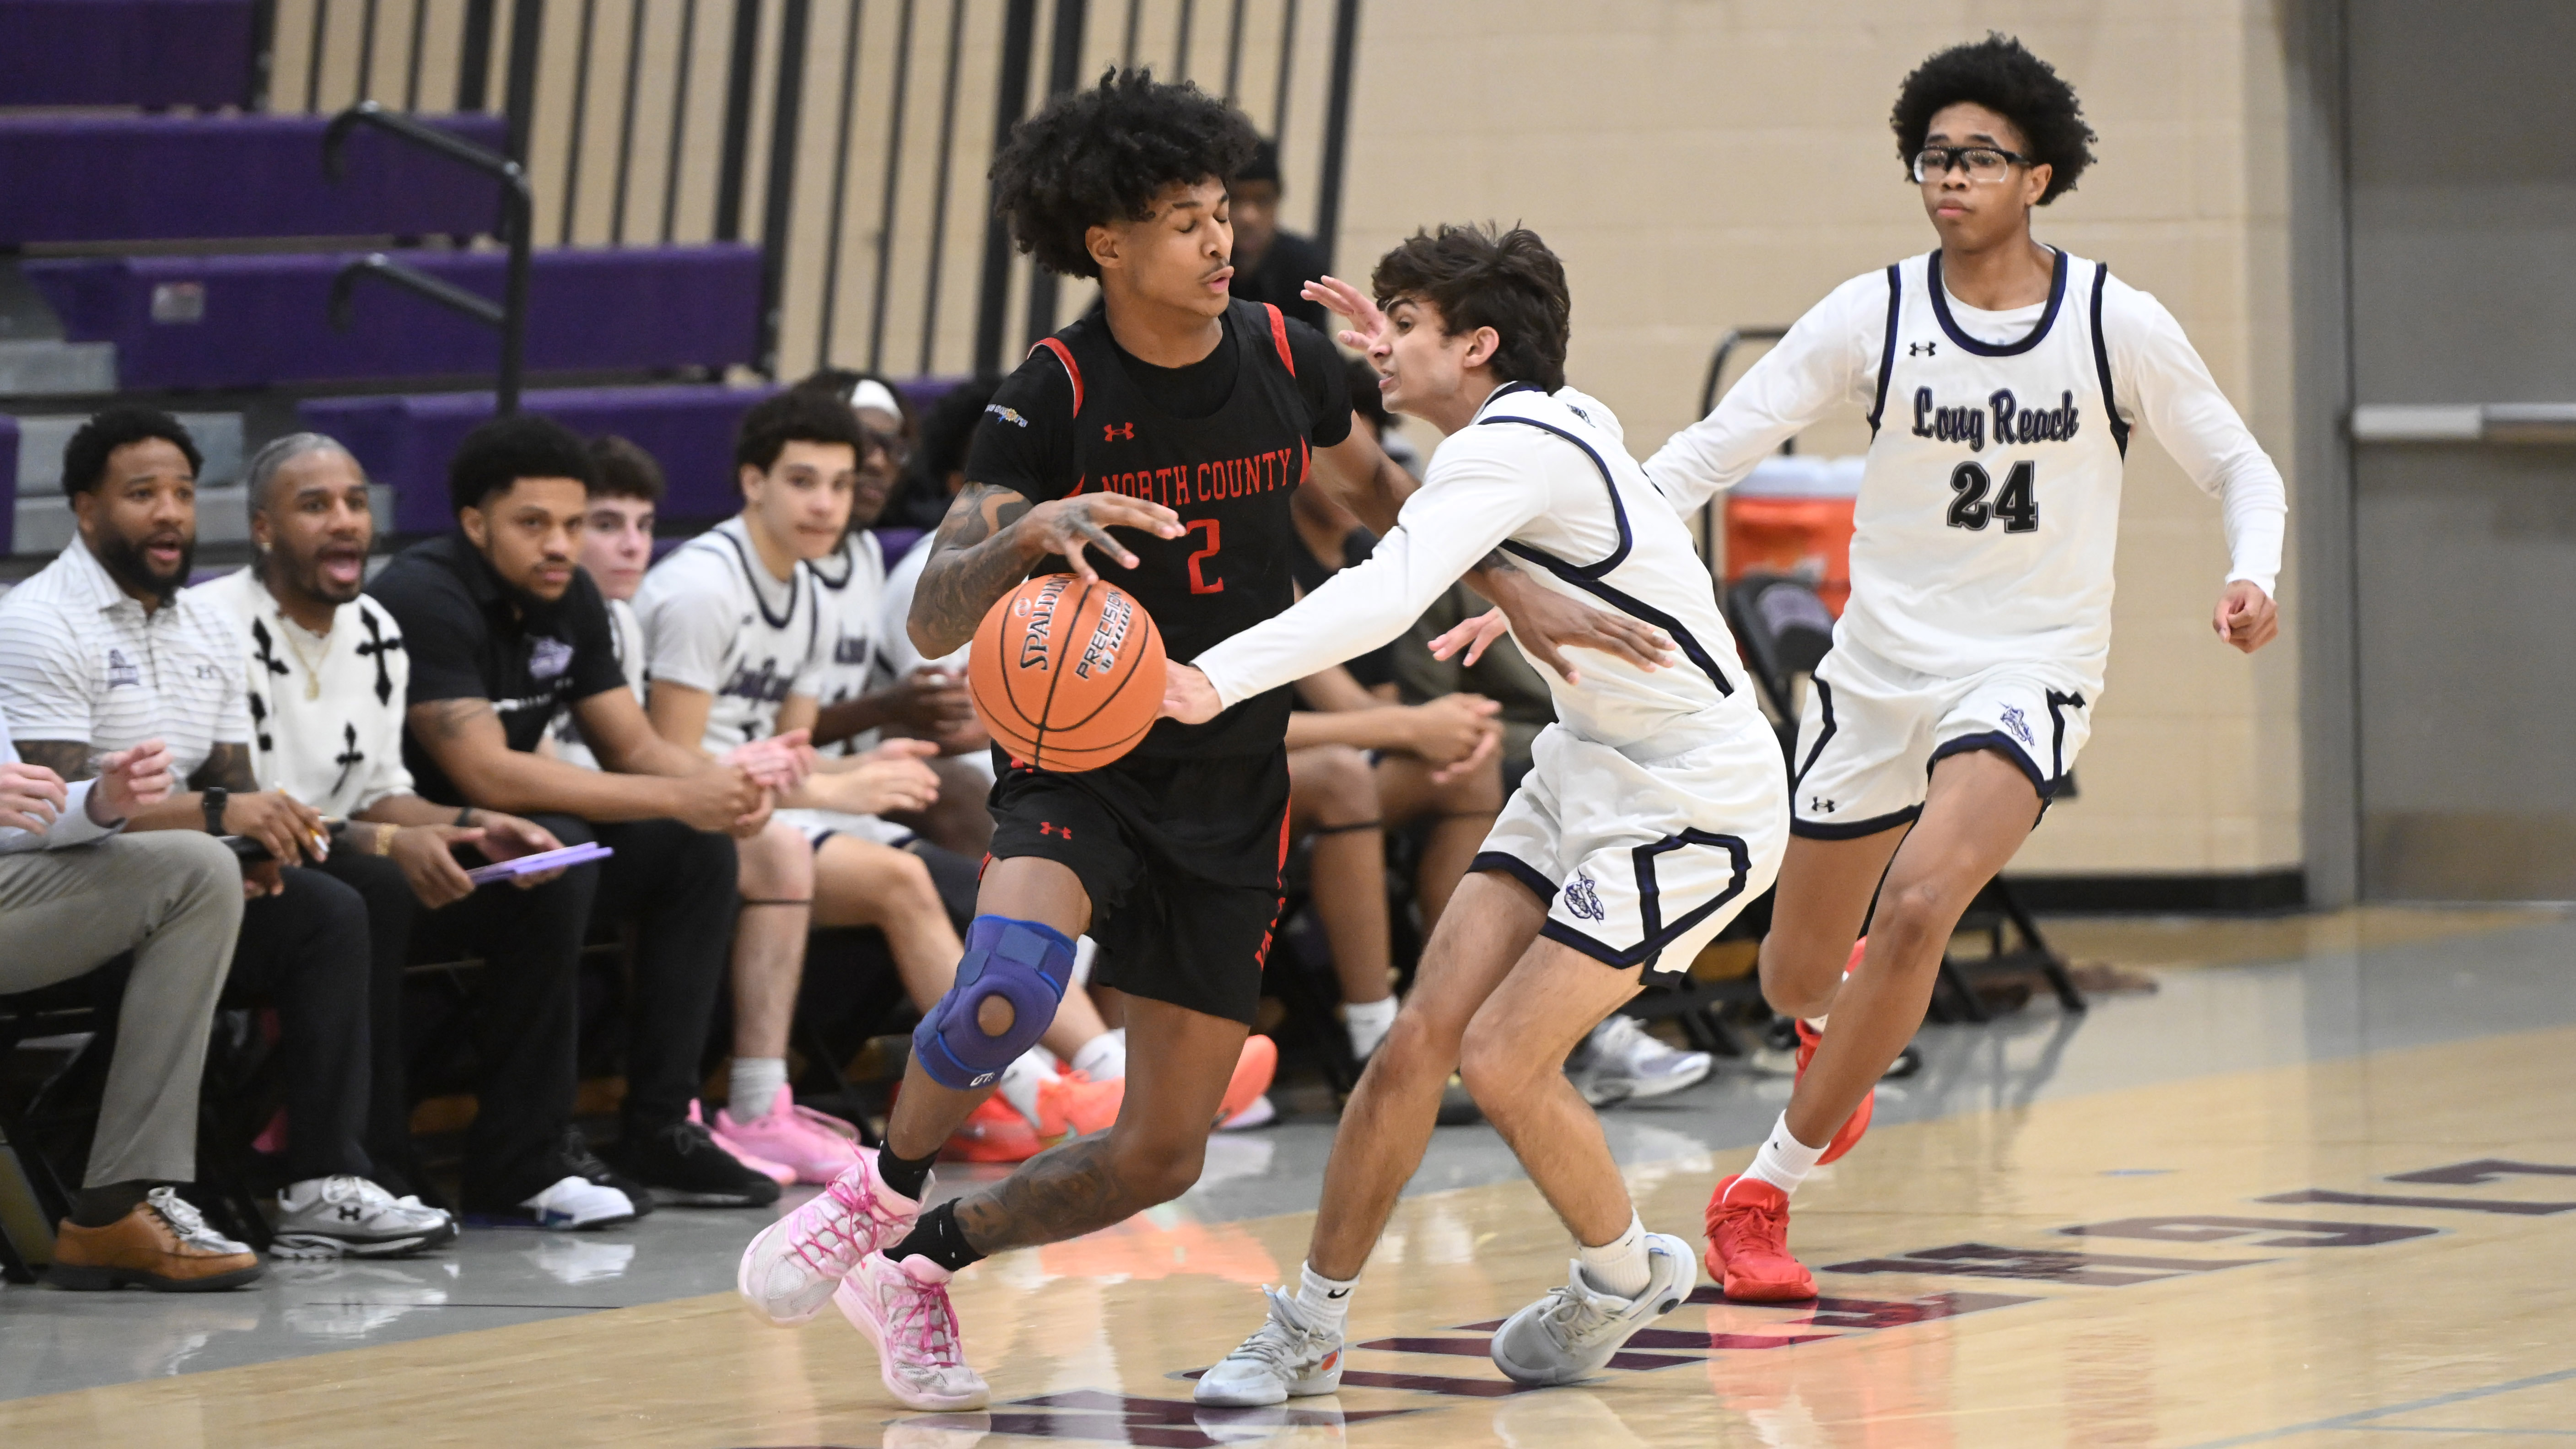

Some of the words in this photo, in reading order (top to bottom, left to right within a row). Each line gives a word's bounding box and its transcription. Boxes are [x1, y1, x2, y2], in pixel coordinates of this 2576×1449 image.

[1912, 385, 1985, 452] Long
[1989, 388, 2080, 444] Reach
[1197, 448, 1291, 501] COUNTY
[1946, 460, 2038, 533] 24
[1186, 518, 1224, 594] 2
[1075, 589, 1122, 679] PRECISION
[720, 1158, 2576, 1449] LIGHTNIN
